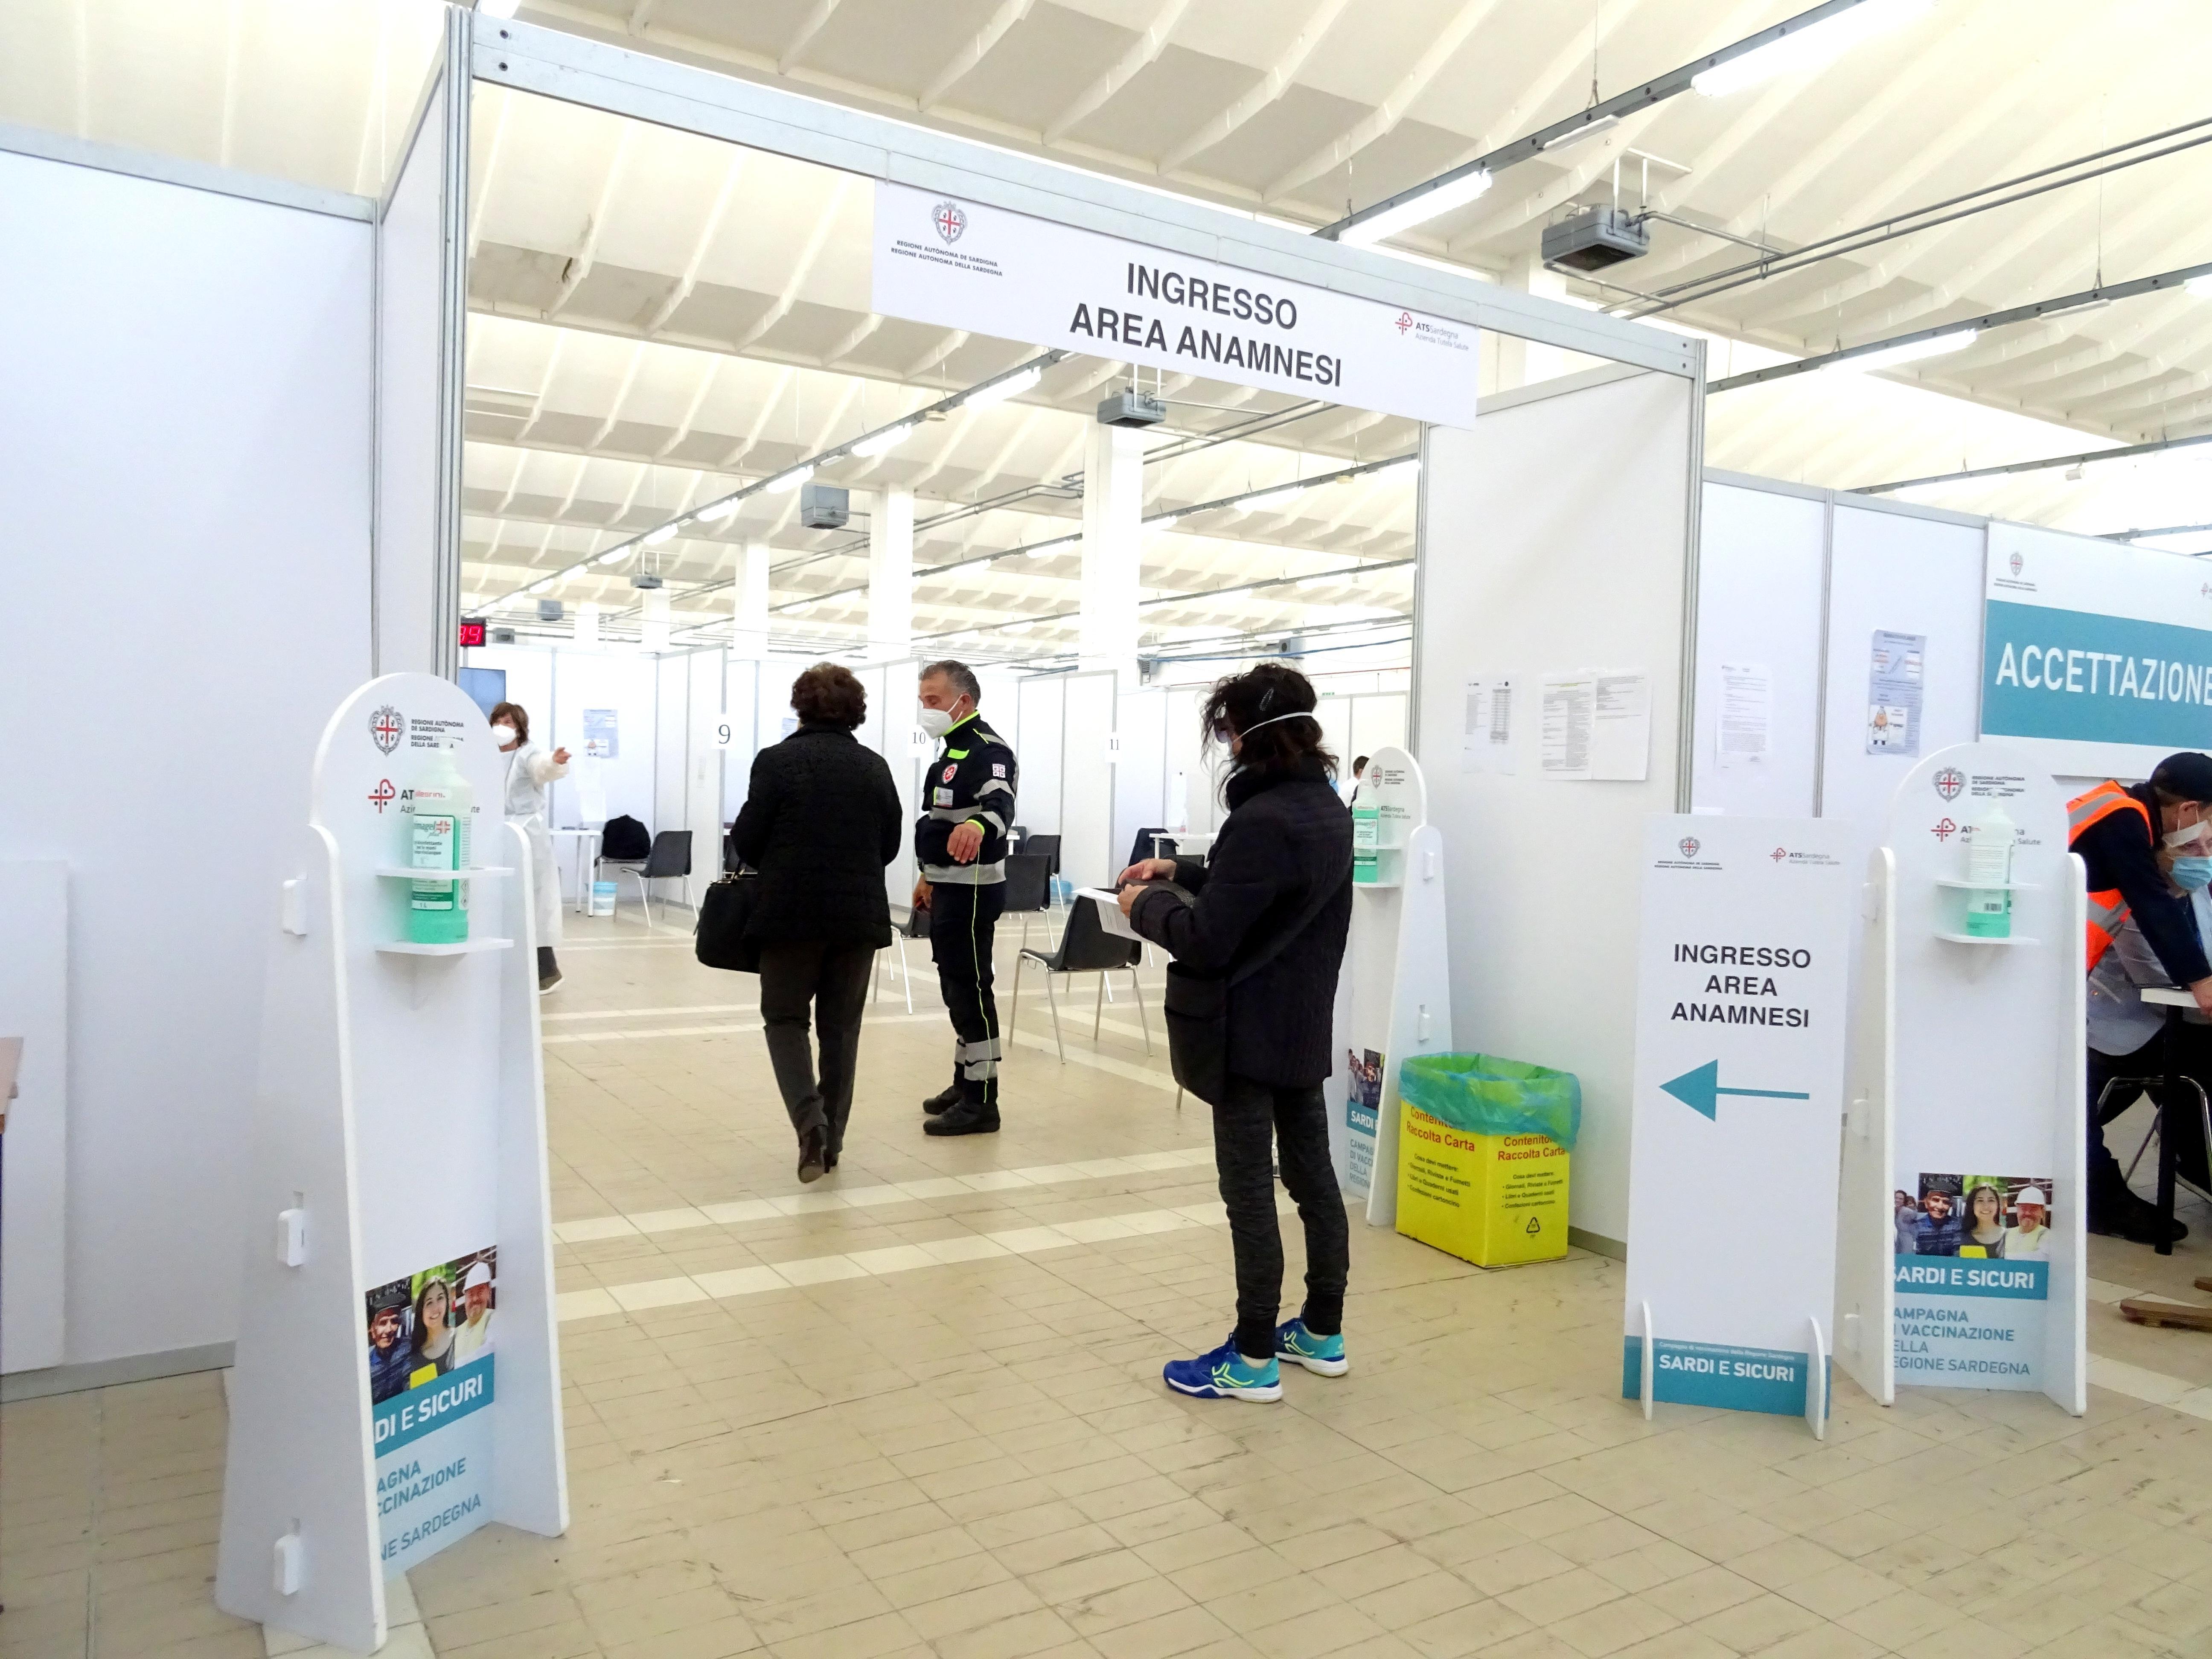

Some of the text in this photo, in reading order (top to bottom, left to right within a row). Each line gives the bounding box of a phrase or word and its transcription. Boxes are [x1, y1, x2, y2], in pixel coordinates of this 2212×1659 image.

[891, 247, 1003, 276] REGIONE AUTONOMA DELLA SARDEGNA
[896, 240, 922, 250] REGIONE
[969, 256, 998, 267] SARDIGNA
[1128, 262, 1297, 330] INGRESSO
[1069, 303, 1341, 387] AREA ANAMNESI
[1415, 333, 1469, 352] Azienda Tutela Salute
[719, 724, 731, 744] 9
[912, 732, 926, 744] 10
[1109, 739, 1120, 750] 11
[1674, 943, 1811, 969] INGRESSO
[1705, 975, 1778, 997] AREA
[1671, 1002, 1809, 1028] ANAMNESI
[1351, 1110, 1373, 1129] SARDI
[1406, 1120, 1475, 1152] Raccolta Carta
[1350, 1150, 1356, 1159] DI
[1498, 1147, 1566, 1161] Raccolta Carta
[1350, 1161, 1367, 1176] DELLA
[1951, 1268, 1963, 1285] E
[1966, 1269, 2034, 1289] SICURI
[1894, 1307, 1968, 1323] AMPAGNA
[1901, 1323, 2014, 1342] VACCINAZIONE
[1894, 1339, 1929, 1353] ELLA
[1659, 1354, 1795, 1382] SARDI E SICURI
[1894, 1356, 2031, 1376] EGIONE SARDEGNA
[401, 1405, 415, 1431] E
[418, 1374, 483, 1423] SICURI
[377, 1460, 422, 1493] AGNA
[401, 1493, 483, 1551] SARDEGNA
